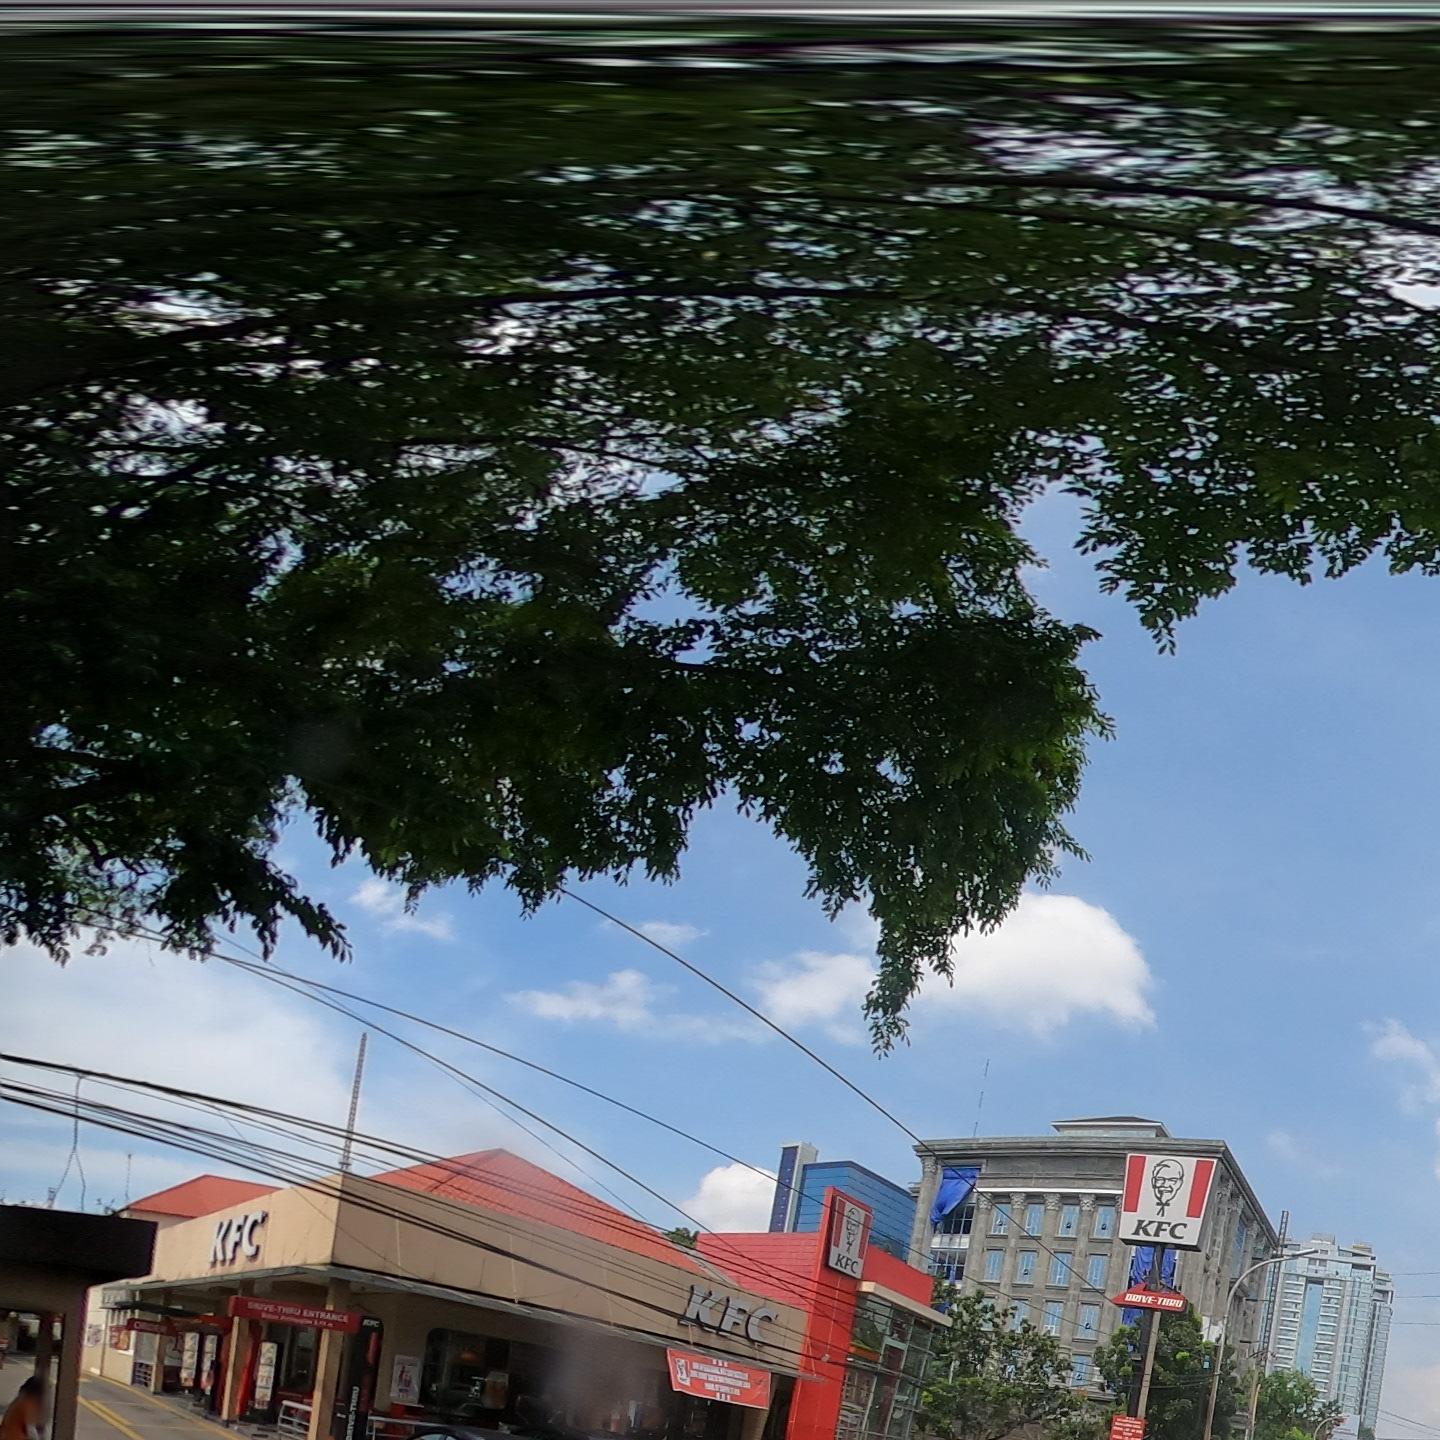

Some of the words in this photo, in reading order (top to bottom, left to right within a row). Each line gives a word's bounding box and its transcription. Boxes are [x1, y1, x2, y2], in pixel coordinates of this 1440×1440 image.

[209, 1210, 265, 1265] KFC
[1131, 1219, 1187, 1240] KFC
[835, 1253, 859, 1274] KFC
[1124, 1293, 1184, 1308] DRIVE-THRU
[680, 1285, 779, 1344] KFC
